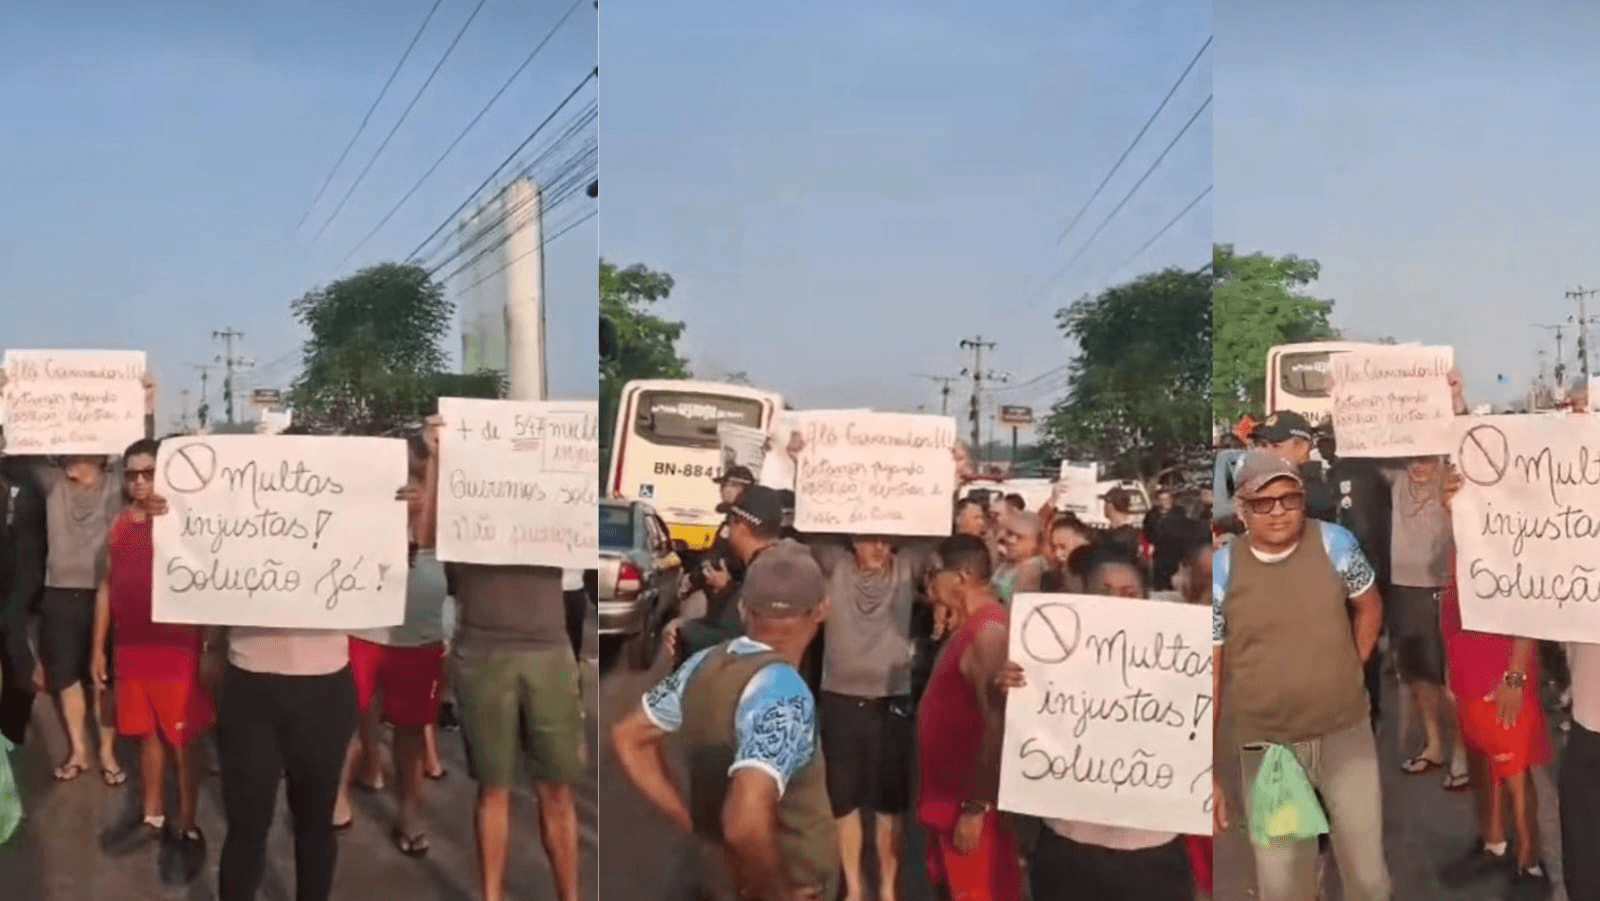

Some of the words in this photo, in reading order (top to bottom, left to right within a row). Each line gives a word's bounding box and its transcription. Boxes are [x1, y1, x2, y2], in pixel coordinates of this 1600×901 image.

[481, 420, 501, 440] de
[221, 459, 344, 510] Multas
[181, 508, 333, 553] injustas!
[166, 556, 300, 599] Solução
[1470, 558, 1600, 608] Soluçã
[1037, 680, 1212, 741] injustas!
[1019, 737, 1173, 793] Solução
